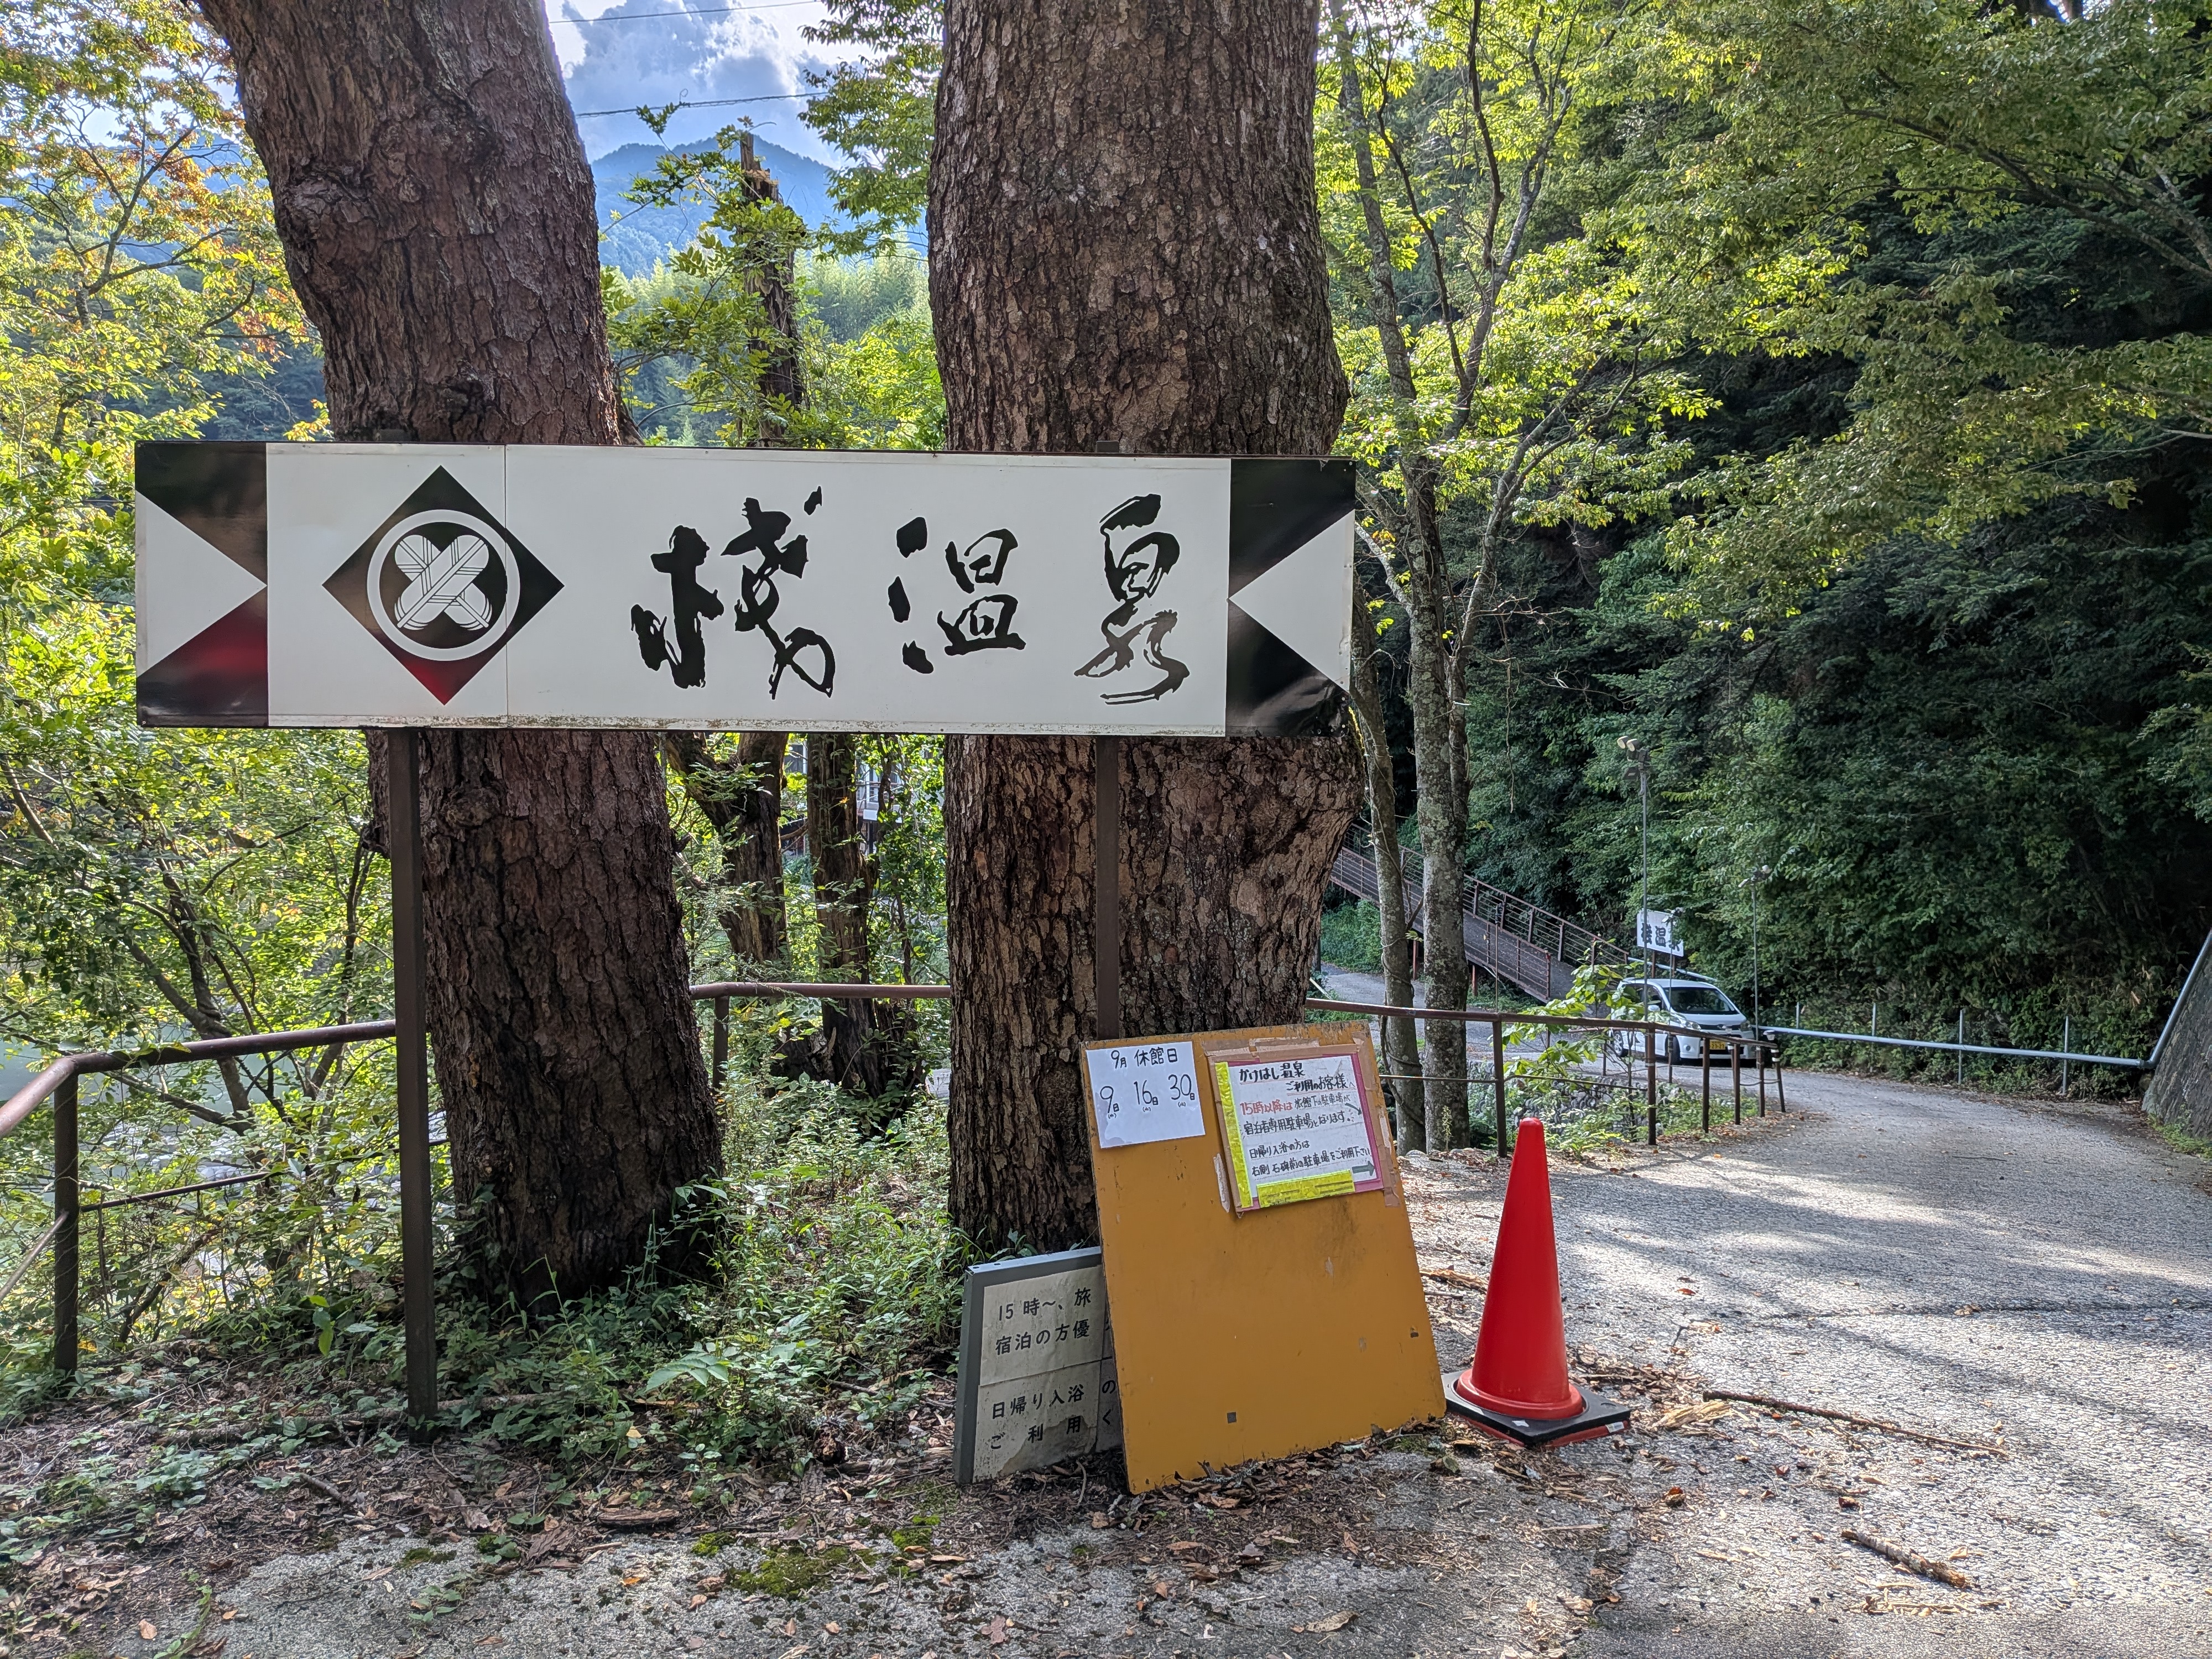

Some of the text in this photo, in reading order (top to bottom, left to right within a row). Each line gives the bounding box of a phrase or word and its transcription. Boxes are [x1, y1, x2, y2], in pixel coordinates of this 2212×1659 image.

[1111, 1046, 1178, 1069] 9月 休館日
[1239, 1061, 1306, 1083] かけはし温泉
[1100, 1074, 1195, 1114] 9日 16日 30日
[1240, 1099, 1293, 1115] 15時以降は
[1249, 1138, 1310, 1159] 日帰り入浴の方は
[995, 1317, 1110, 1356] 宿泊の方優
